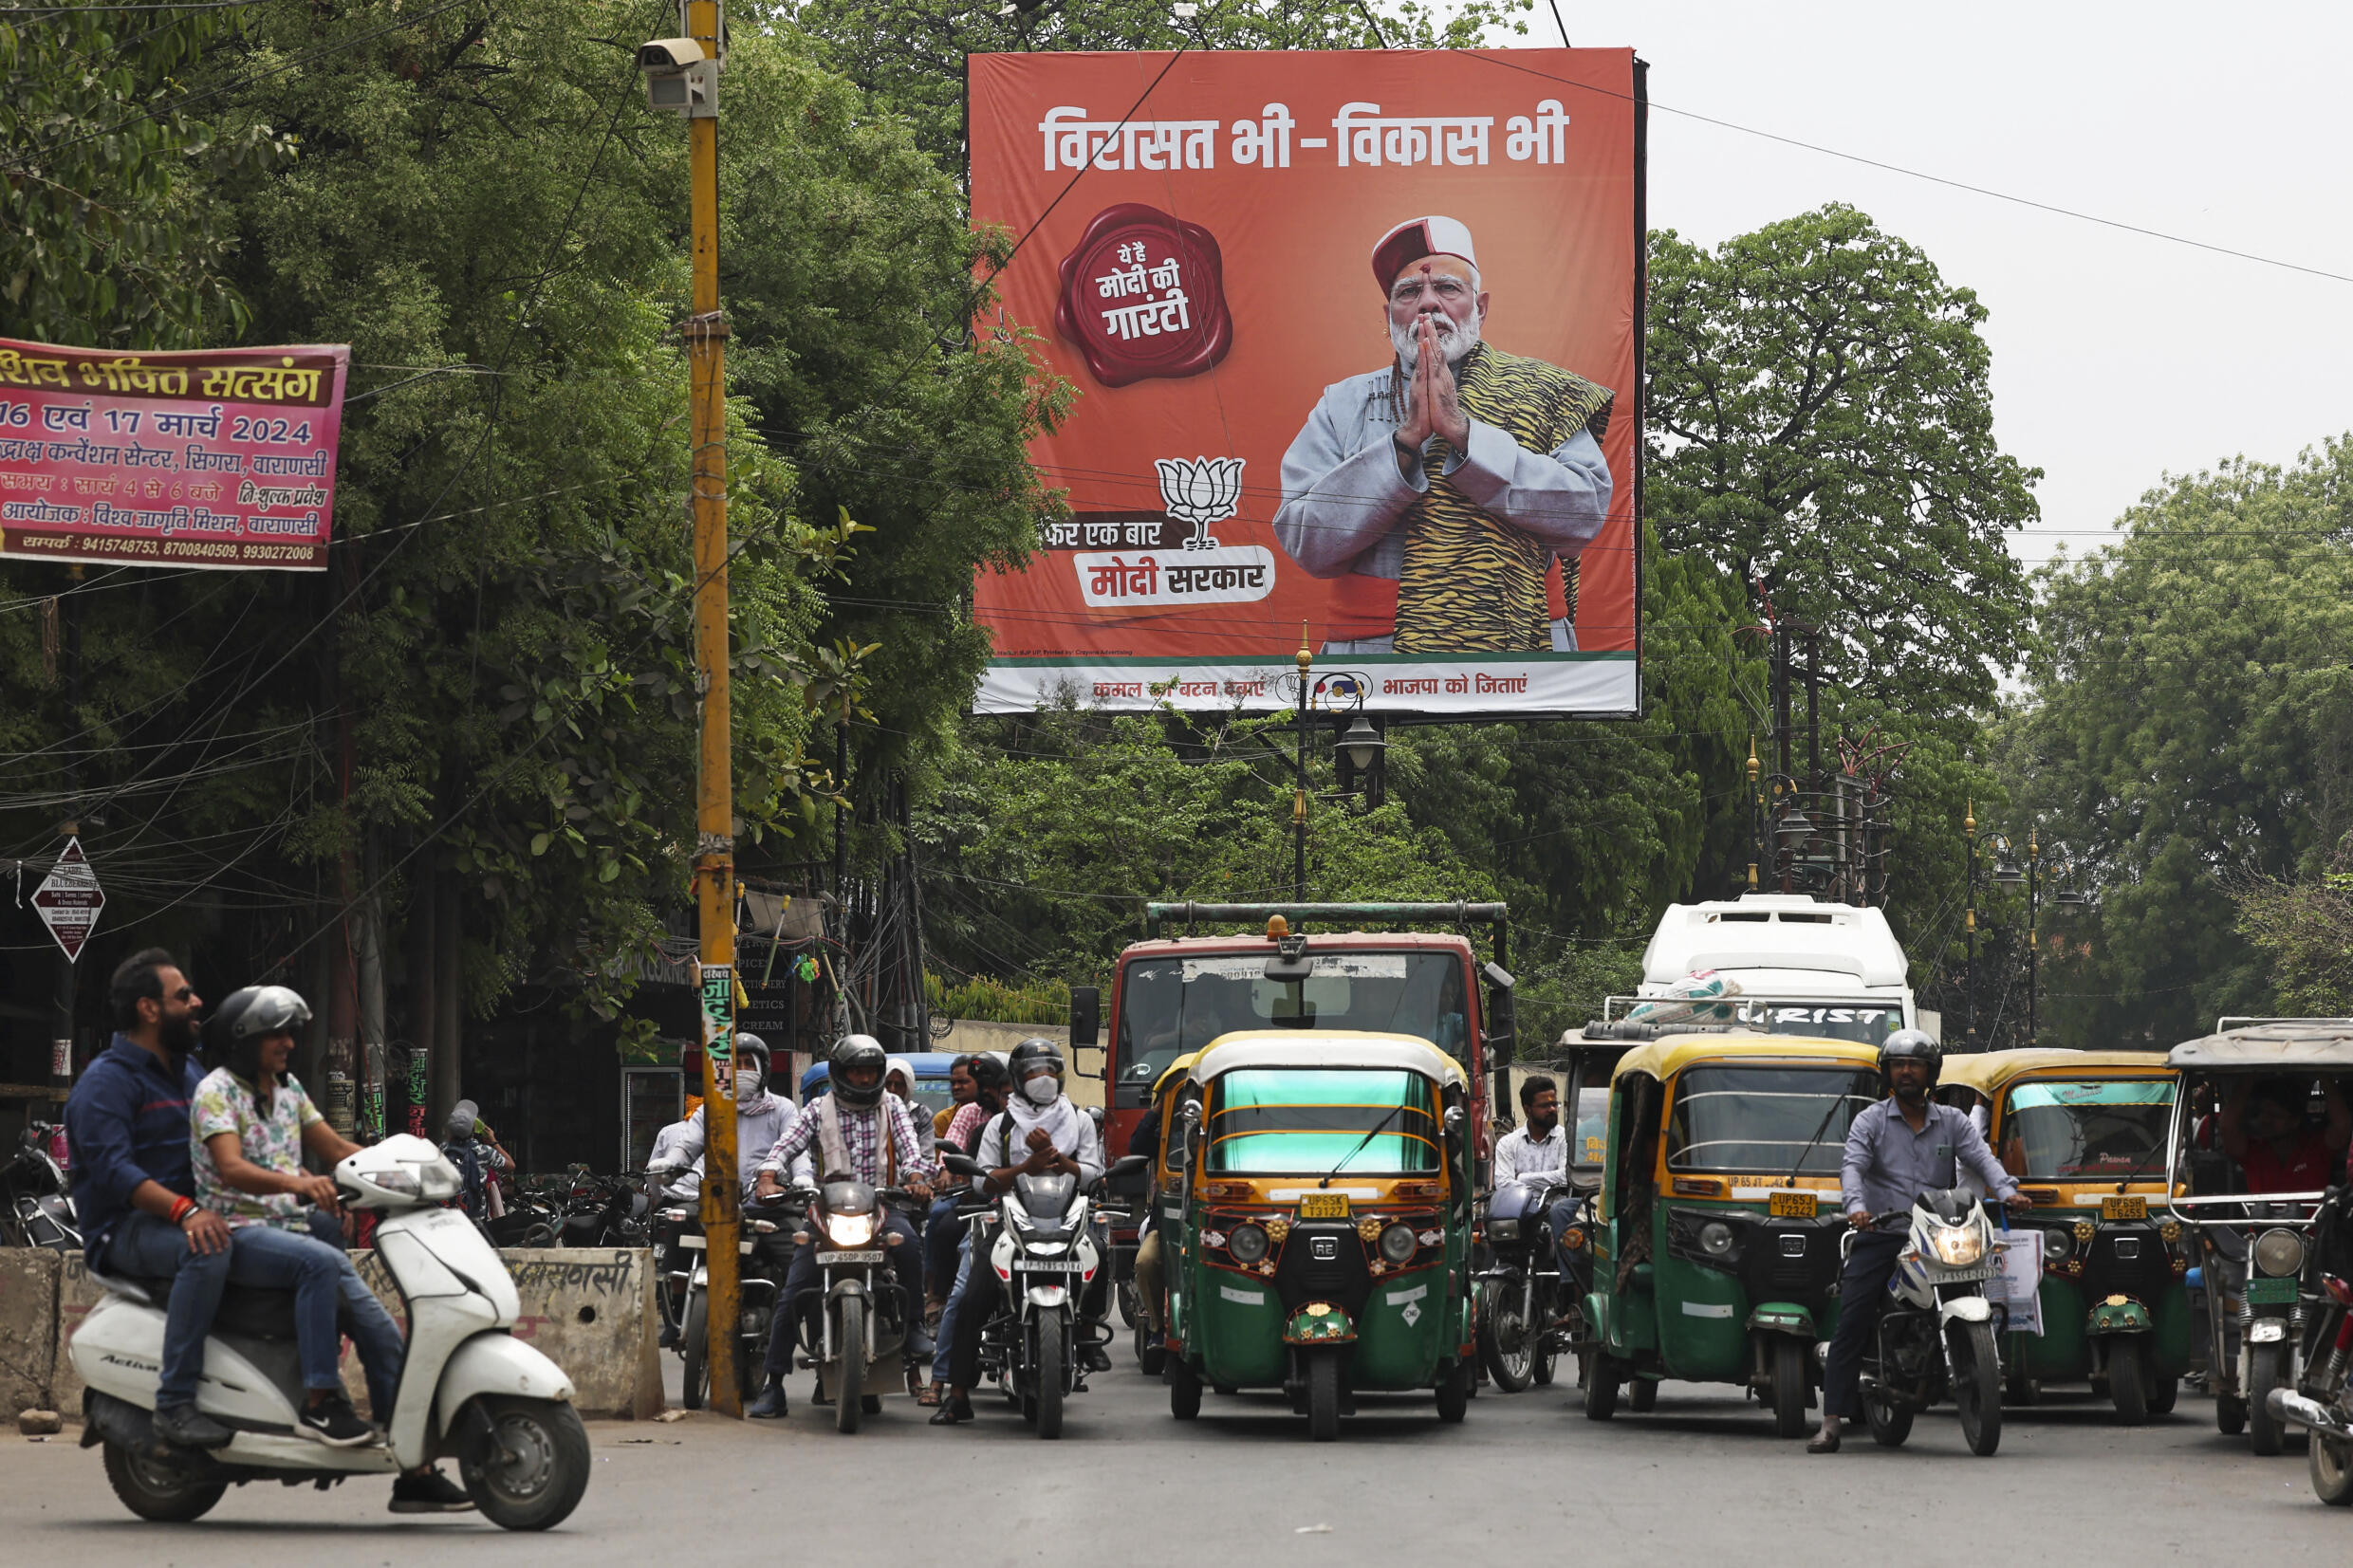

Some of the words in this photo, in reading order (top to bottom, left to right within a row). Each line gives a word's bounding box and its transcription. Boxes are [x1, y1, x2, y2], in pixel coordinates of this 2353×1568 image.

[1039, 106, 1219, 171] विरासत
[1232, 102, 1295, 169] भी
[1331, 102, 1494, 167] विकास
[1506, 100, 1569, 164] भी
[1117, 244, 1133, 265] ये
[1132, 241, 1147, 263] है
[1095, 264, 1149, 299] मोदी
[1148, 257, 1181, 290] की
[1102, 287, 1191, 341] गारंटी
[197, 357, 323, 402] सत्संग
[44, 401, 91, 431] एवं
[104, 409, 140, 434] 17
[154, 405, 222, 438] मार्च
[232, 416, 312, 444] 2024
[0, 439, 44, 463] द्राक्ष
[253, 451, 327, 476] वाराणसी
[1, 472, 53, 491] समय
[75, 473, 118, 494] सायं
[123, 479, 138, 496] 4
[144, 477, 163, 499] से
[170, 481, 183, 499] 6
[190, 482, 221, 501] बजे
[3, 498, 80, 523] आयोजक
[248, 512, 319, 536] वाराणसी
[82, 537, 159, 556] 9415748753,
[163, 542, 239, 560] 8700840509,
[243, 544, 314, 560] 9930272008
[1084, 522, 1121, 546] एक
[1123, 522, 1162, 545] बार
[1087, 556, 1159, 598] मोदी
[1164, 564, 1267, 594] सरकार
[1093, 682, 1142, 698] कमल
[1179, 681, 1217, 698] बटन
[1382, 677, 1438, 696] भाजपा
[1445, 673, 1469, 694] को
[1475, 673, 1529, 695] जिताएं
[647, 955, 690, 987] CORNE
[1737, 1007, 1886, 1024] URIST
[1728, 1176, 1739, 1187] UP
[1315, 1244, 1334, 1255] RE
